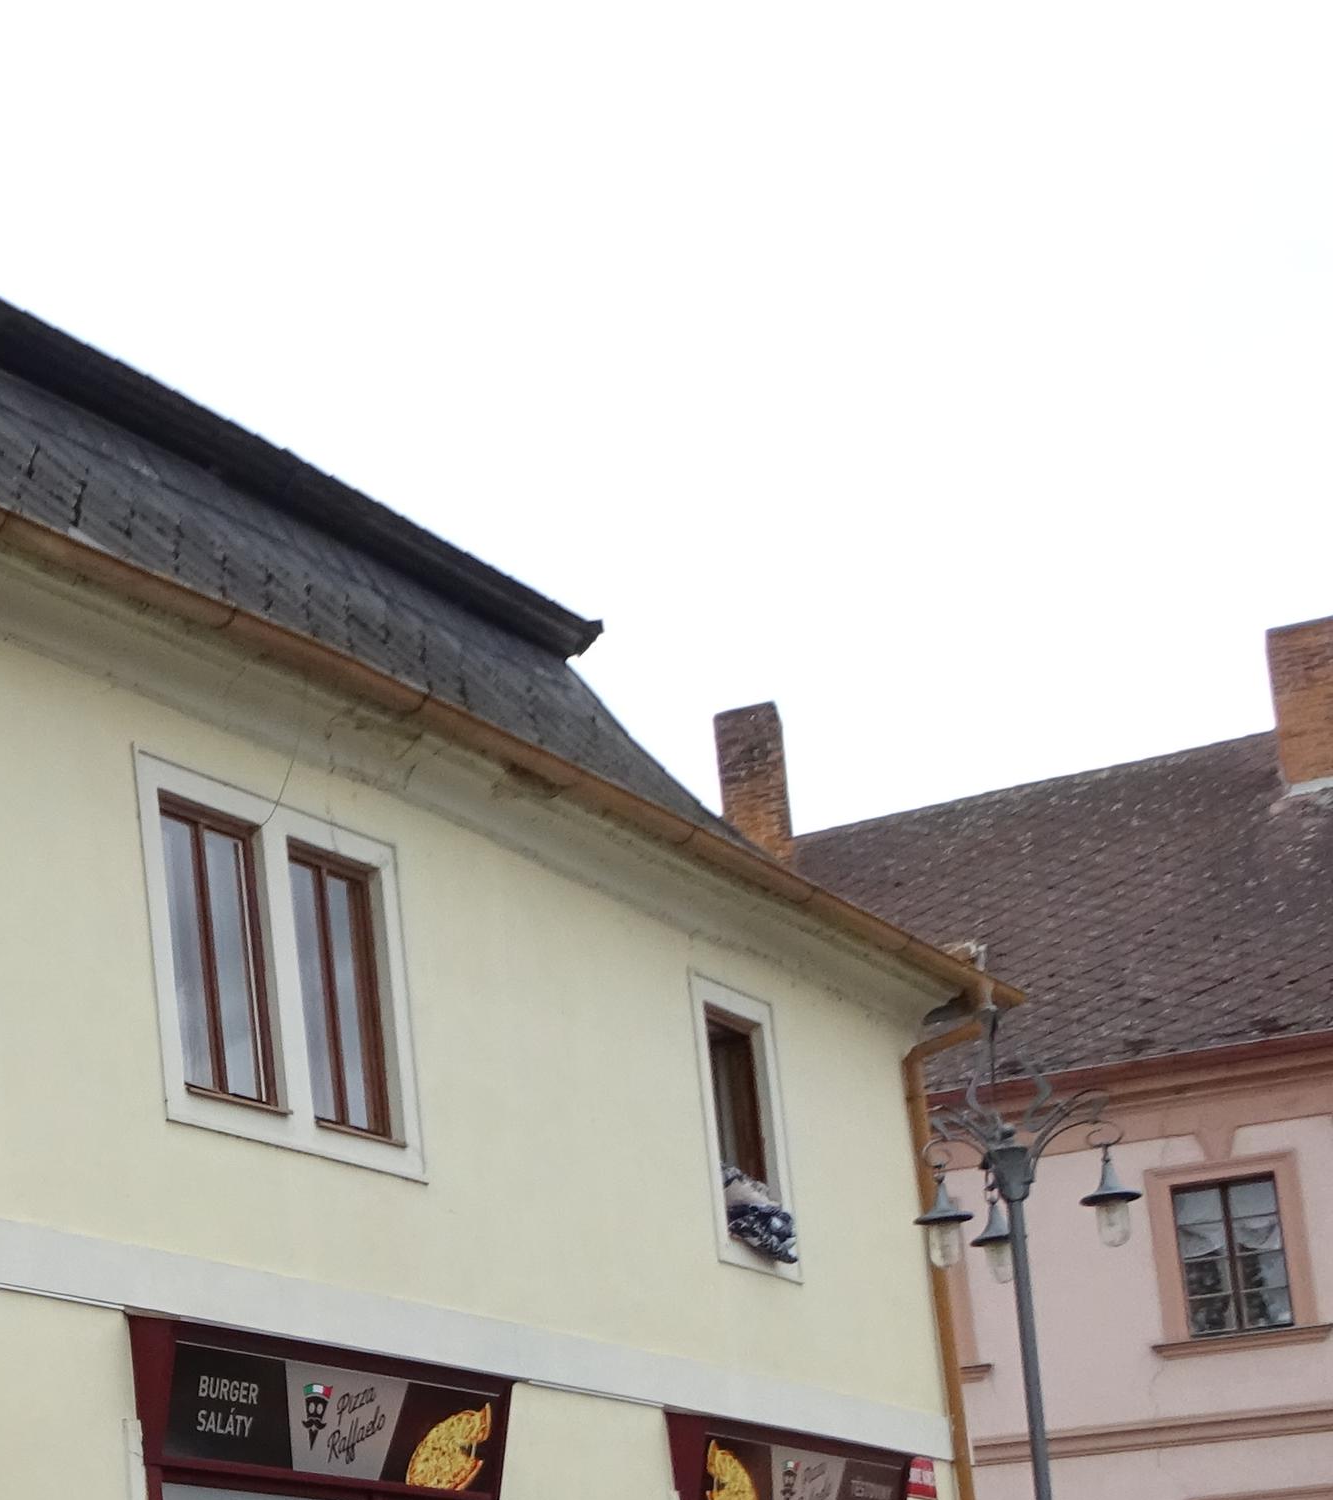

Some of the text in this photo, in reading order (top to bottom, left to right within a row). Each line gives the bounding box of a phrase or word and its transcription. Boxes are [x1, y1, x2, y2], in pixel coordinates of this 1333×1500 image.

[198, 1375, 259, 1405] BURGER
[336, 1386, 376, 1426] Pizza
[196, 1407, 253, 1437] SALÁTY
